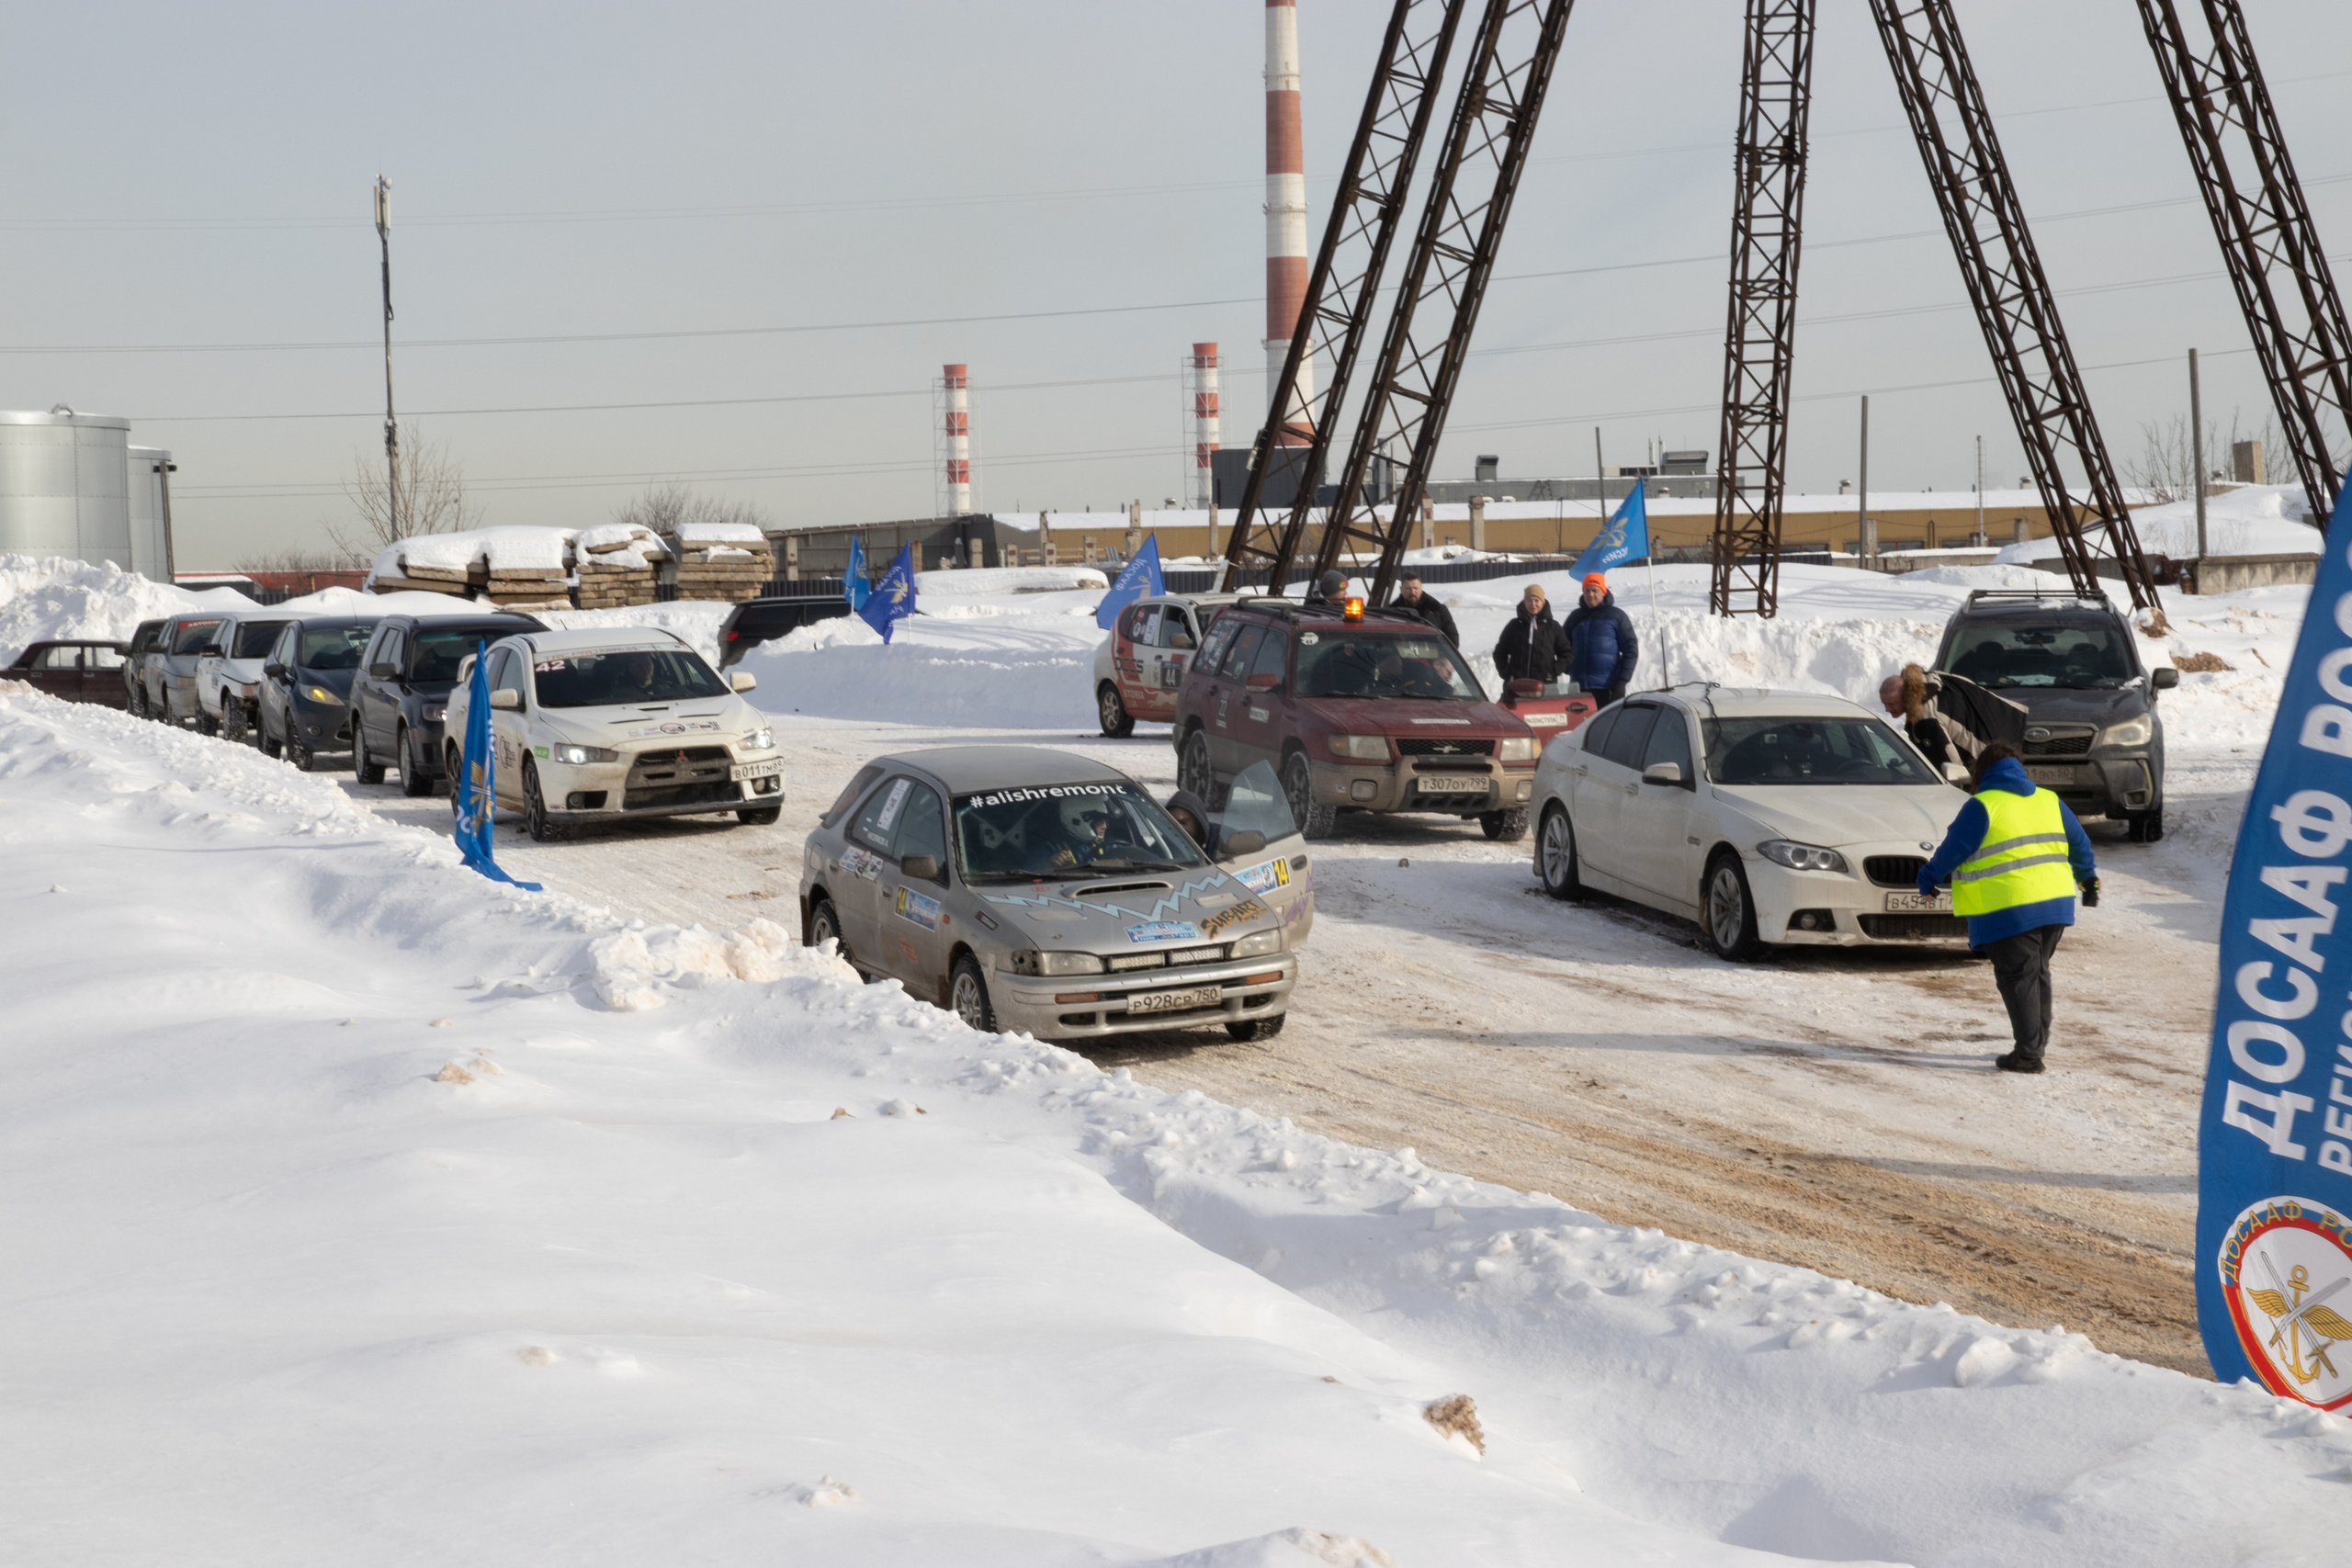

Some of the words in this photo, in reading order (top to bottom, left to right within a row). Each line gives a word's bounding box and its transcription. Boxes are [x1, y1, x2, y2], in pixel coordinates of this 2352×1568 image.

[536, 660, 566, 672] 42
[1165, 668, 1177, 686] 44
[1469, 777, 1487, 787] 799
[969, 784, 1127, 809] #alishremont
[1273, 858, 1289, 886] 14
[2222, 789, 2352, 1161] ДОСААФ
[1195, 988, 1217, 1001] 750
[2220, 1200, 2302, 1283] ДОСААФ
